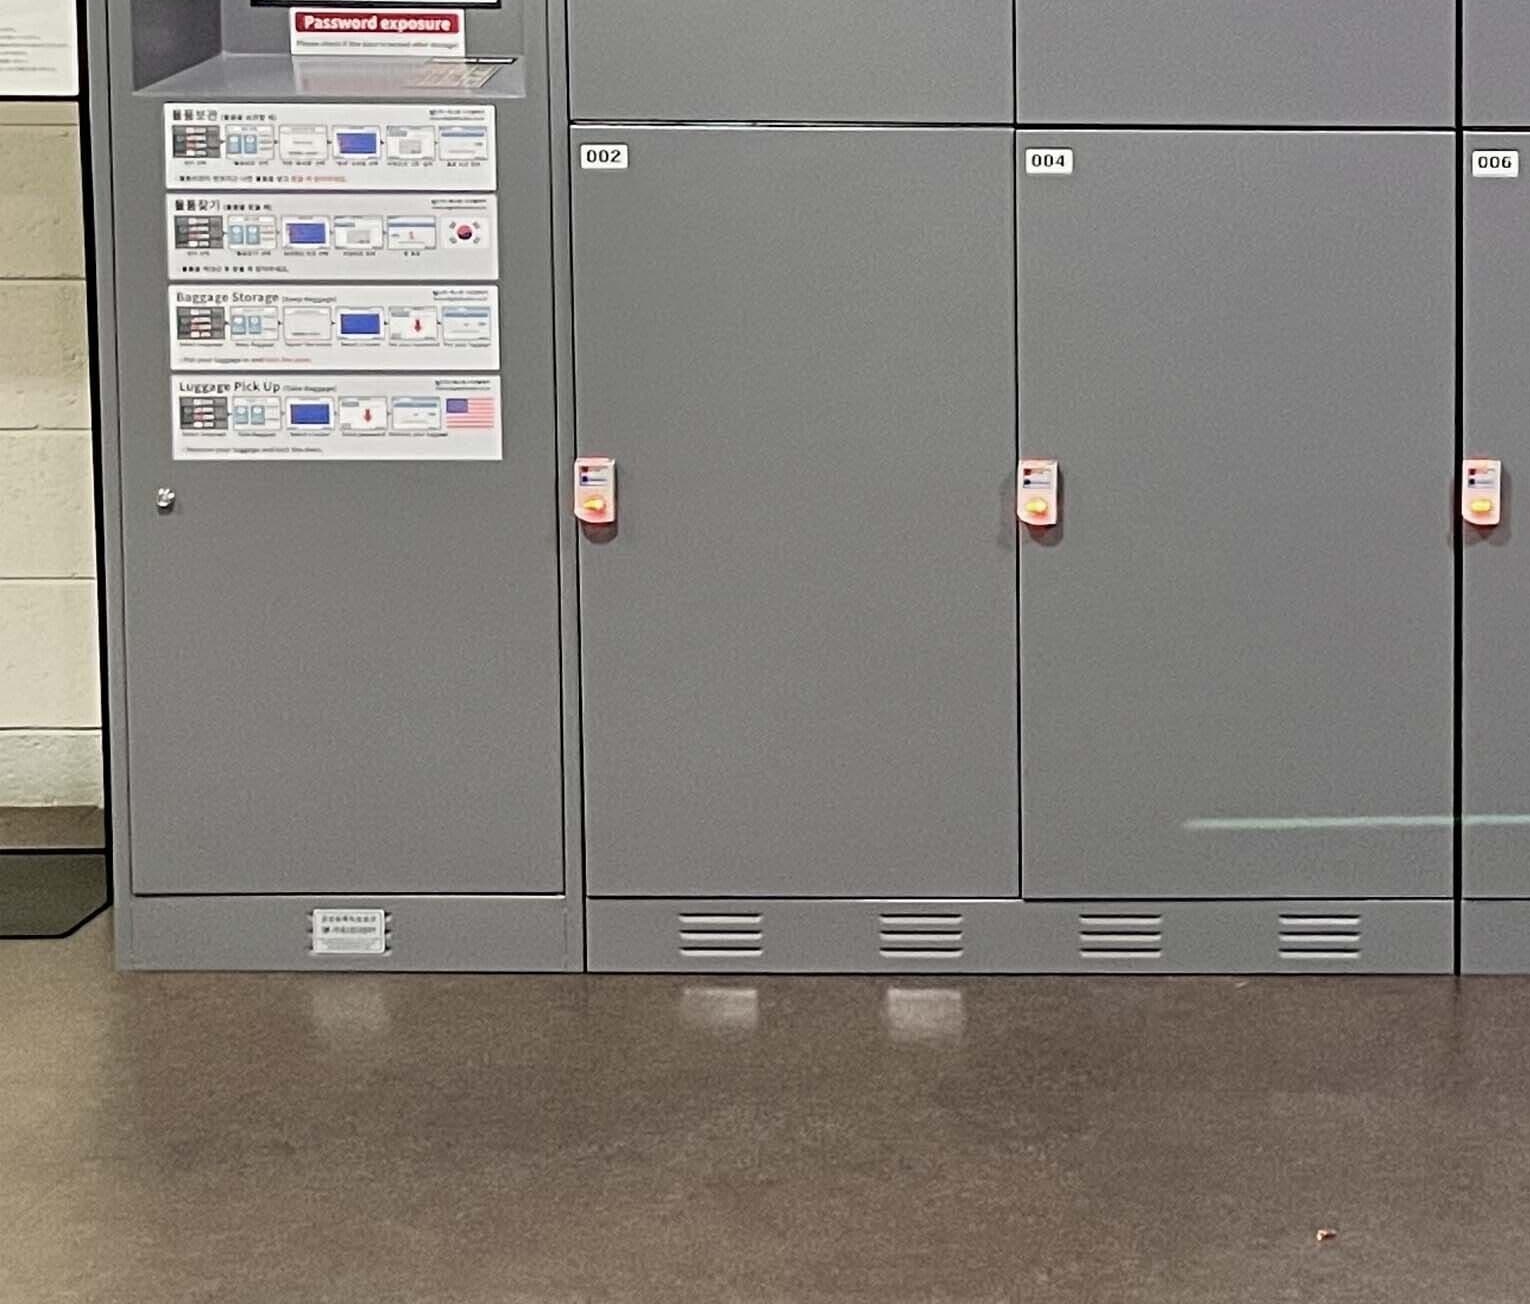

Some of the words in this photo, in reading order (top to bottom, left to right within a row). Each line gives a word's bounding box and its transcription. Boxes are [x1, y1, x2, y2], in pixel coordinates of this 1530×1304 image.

[303, 15, 378, 31] Password
[380, 17, 452, 33] exposure
[587, 150, 621, 163] 002
[1031, 154, 1065, 168] 004
[1478, 156, 1512, 169] 006
[176, 292, 229, 305] Baggage
[232, 292, 280, 305] Storage
[179, 381, 231, 394] Luggage
[233, 380, 260, 392] Pick
[263, 381, 281, 395] Up
